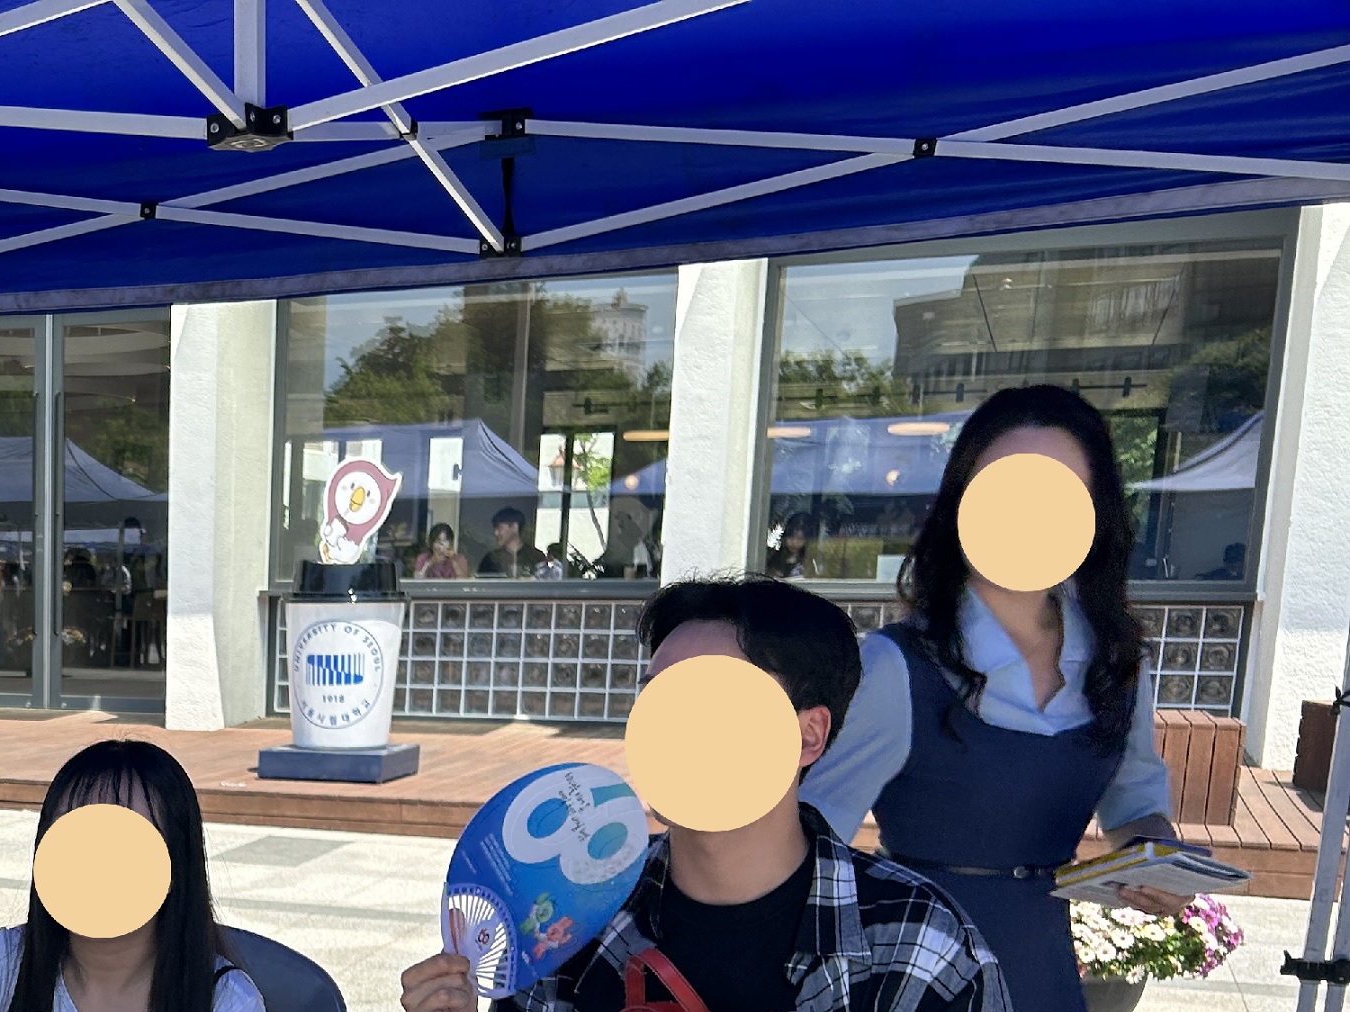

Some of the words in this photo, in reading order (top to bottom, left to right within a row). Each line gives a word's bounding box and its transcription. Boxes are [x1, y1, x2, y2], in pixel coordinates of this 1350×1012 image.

[293, 623, 337, 672] UNIVERSITY
[343, 625, 360, 636] OF
[362, 635, 382, 672] SEOUL
[322, 694, 345, 703] 1918
